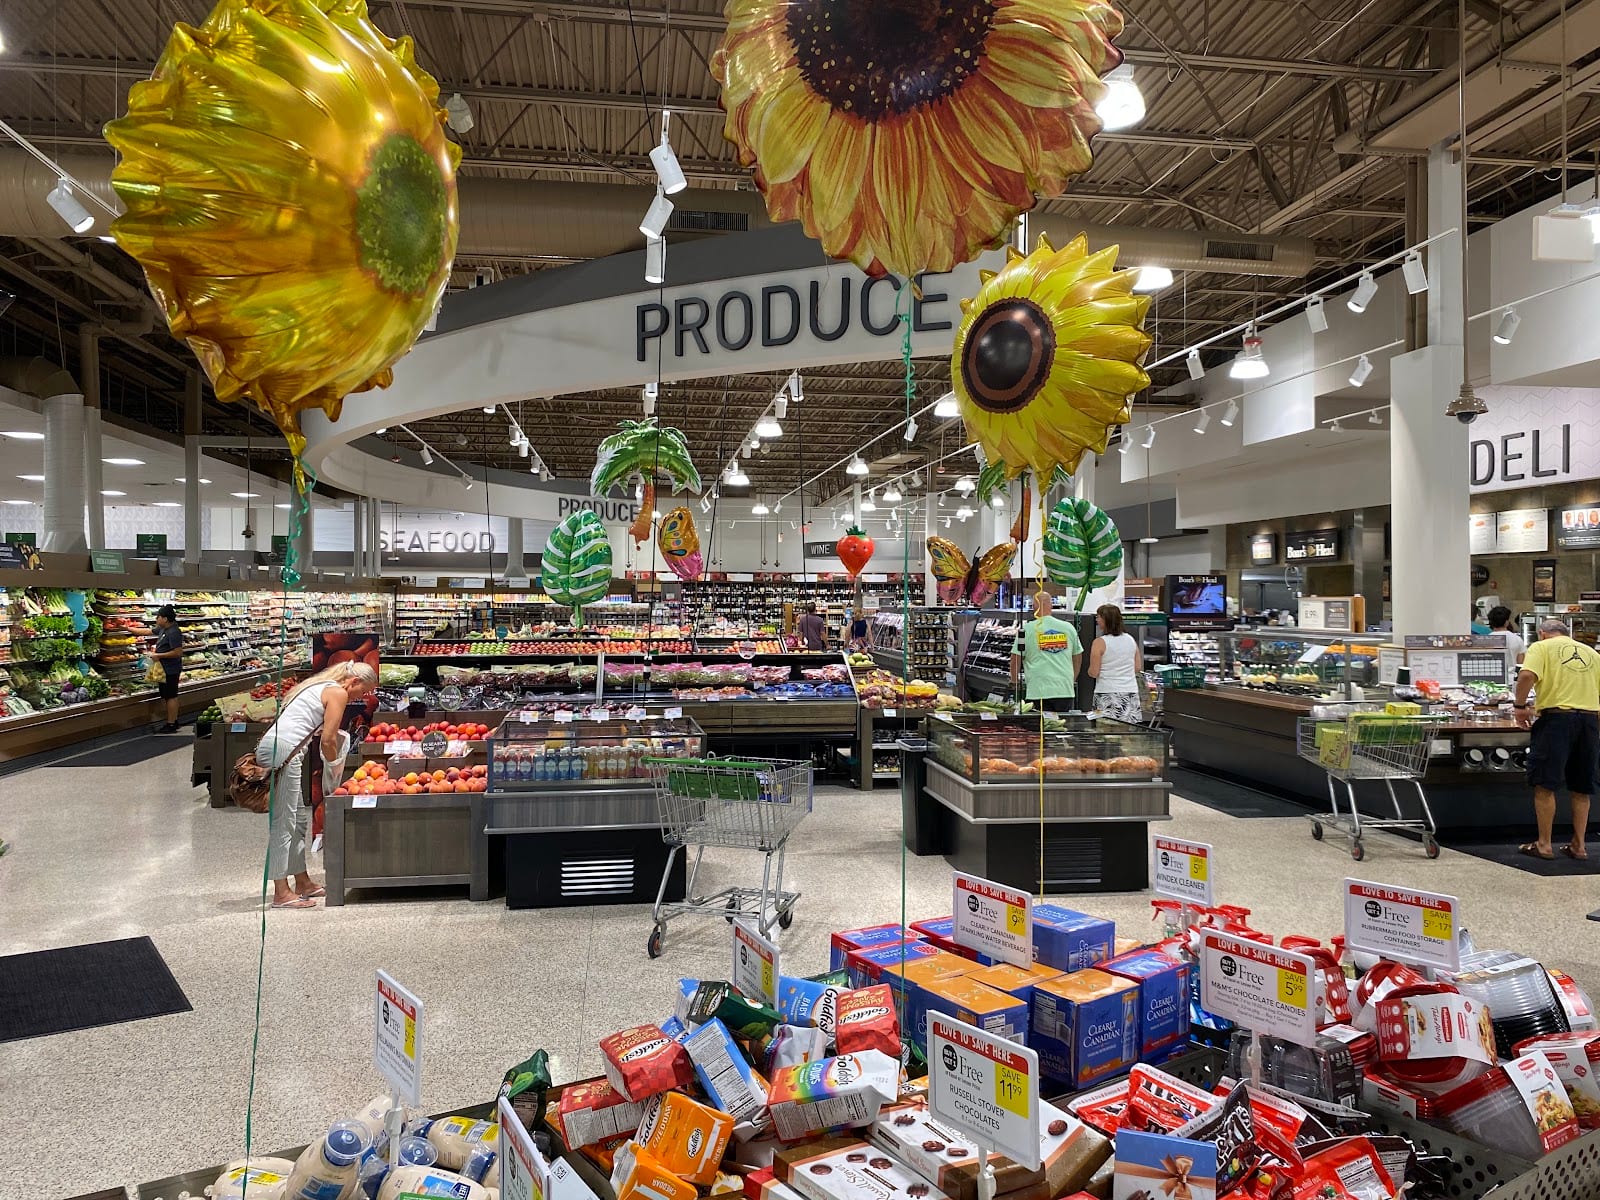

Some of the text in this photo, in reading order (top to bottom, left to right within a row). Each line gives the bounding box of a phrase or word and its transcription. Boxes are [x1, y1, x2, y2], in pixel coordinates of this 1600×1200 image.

[636, 272, 952, 361] PRODUCE
[1471, 424, 1570, 485] DELI
[378, 530, 495, 552] SEAFOOD
[810, 544, 830, 554] WINE
[1316, 542, 1334, 556] Head
[966, 880, 1020, 904] LOVE TO SAVE HERE.
[1178, 878, 1205, 890] CLEANER
[1362, 886, 1442, 908] LOVE TO SAVE HERE.
[980, 902, 998, 918] Free
[1384, 906, 1410, 924] Free
[1430, 910, 1449, 920] SAVE
[960, 924, 984, 939] SPARKLING
[986, 934, 1002, 944] WATER
[1002, 940, 1026, 954] BEVERAGE
[991, 928, 1016, 940] CANADIAN
[1362, 924, 1444, 946] RUBBERMAID FOOD STORAGE
[1384, 936, 1421, 948] CONTAINERS
[1217, 938, 1296, 970] LOVE TO SAVE HERE.
[1239, 964, 1264, 986] Free
[1284, 972, 1304, 985] SAVE
[799, 997, 810, 1016] BABY
[1146, 1002, 1178, 1020] CANADIAN
[1150, 996, 1174, 1010] CLEARLY
[1234, 988, 1274, 1007] CHOCOLATE
[1275, 1002, 1306, 1017] CANDIES
[840, 1006, 889, 1025] Goldfish
[1083, 1028, 1121, 1048] CANADIAN
[1088, 1019, 1116, 1036] CLEARLY
[620, 1038, 671, 1064] Goldfish
[939, 1024, 1014, 1065] LOVE TO SAVE HERE.
[960, 1055, 984, 1084] Free
[1002, 1067, 1022, 1084] SAVE
[950, 1084, 1005, 1119] RUSSELL STOVER
[639, 1092, 663, 1148] Goldfish
[954, 1100, 1000, 1130] CHOCOLATES
[652, 1104, 672, 1149] CHEDDAR
[688, 1128, 702, 1158] Goldfish
[712, 1137, 726, 1164] CHEDDAR
[652, 1179, 677, 1196] CHEDDAR
